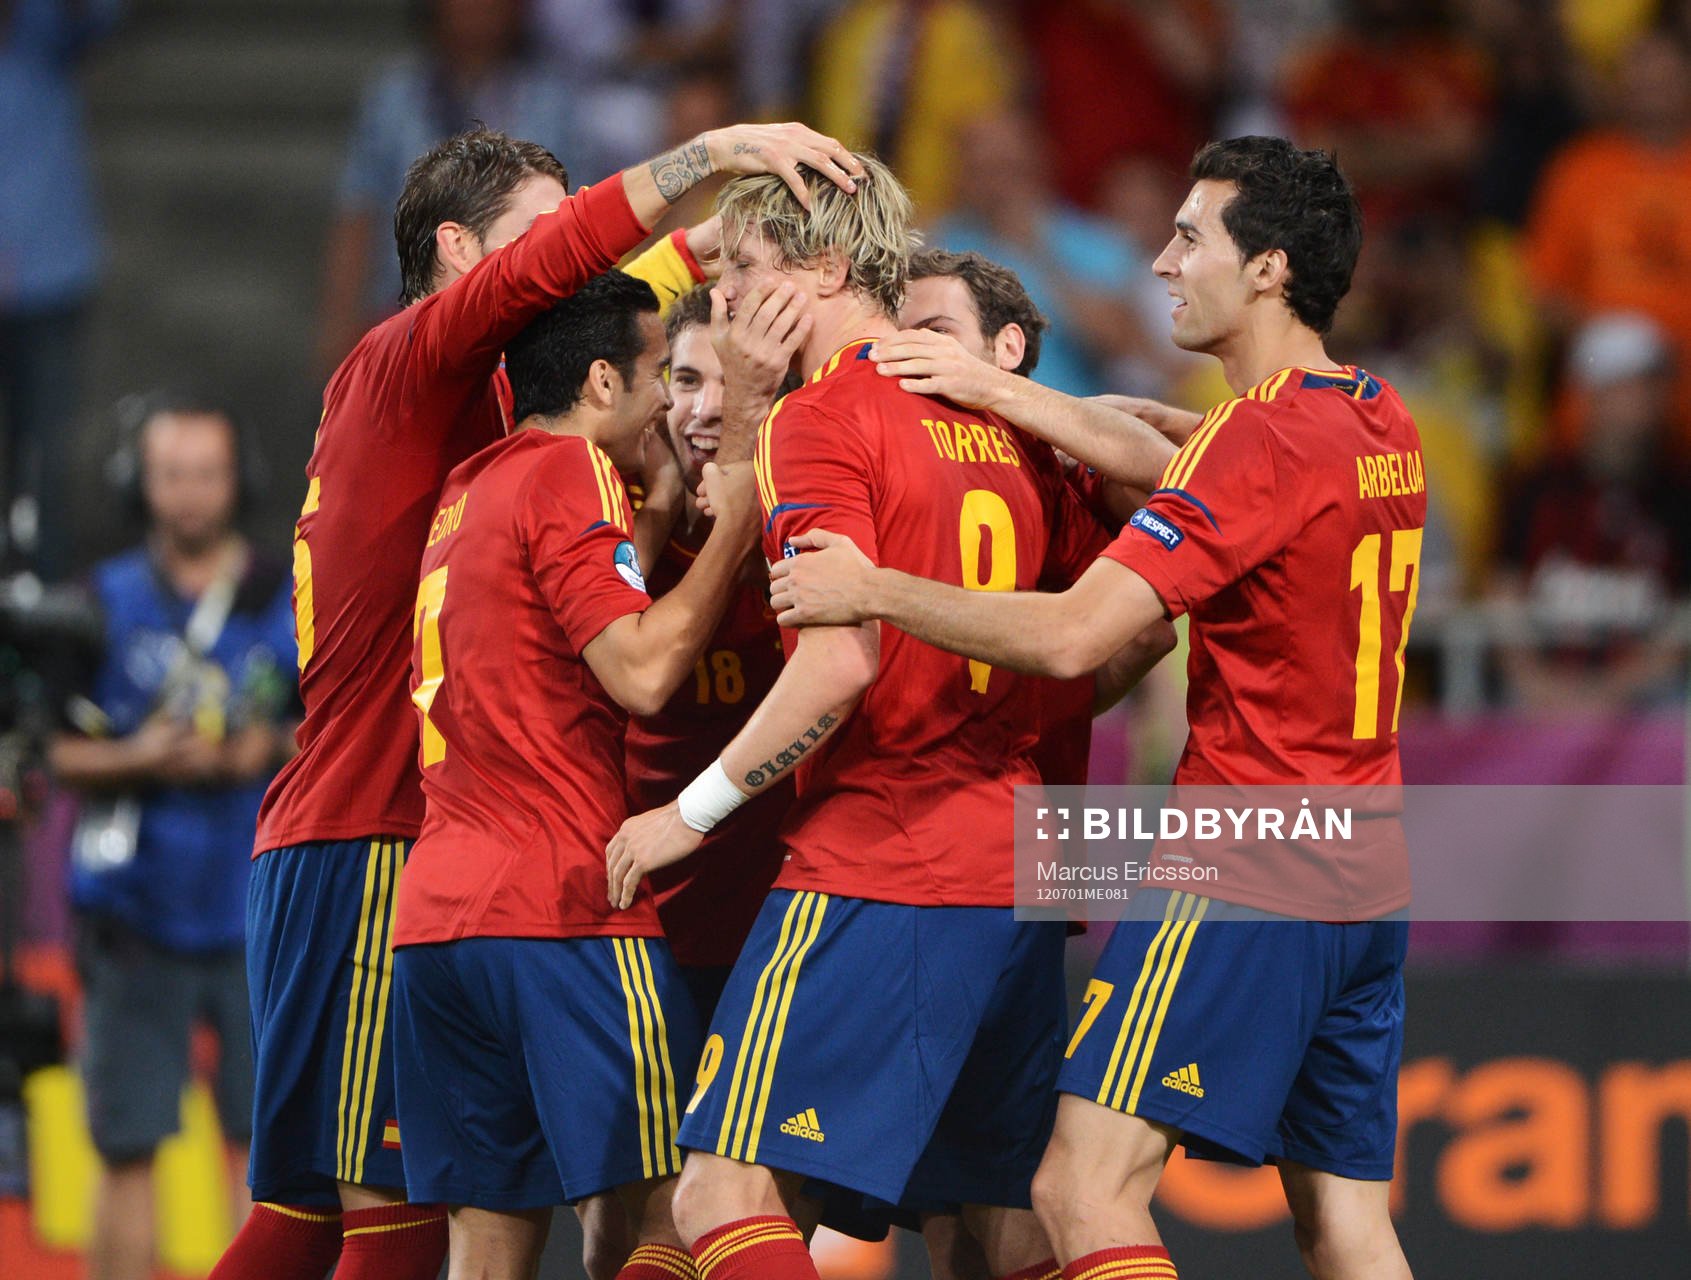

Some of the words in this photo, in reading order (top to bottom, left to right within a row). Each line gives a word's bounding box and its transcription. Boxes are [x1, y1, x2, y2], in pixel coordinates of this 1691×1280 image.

[920, 419, 1021, 468] TORRES
[1355, 450, 1425, 499] ARBELOA
[427, 491, 468, 548] EDRO
[1141, 514, 1180, 545] RESPECT
[1349, 527, 1423, 739] 17
[695, 650, 745, 705] 18
[1064, 978, 1115, 1060] 7
[685, 1033, 725, 1114] 9
[1161, 1076, 1205, 1098] adidas
[780, 1122, 825, 1143] adidas
